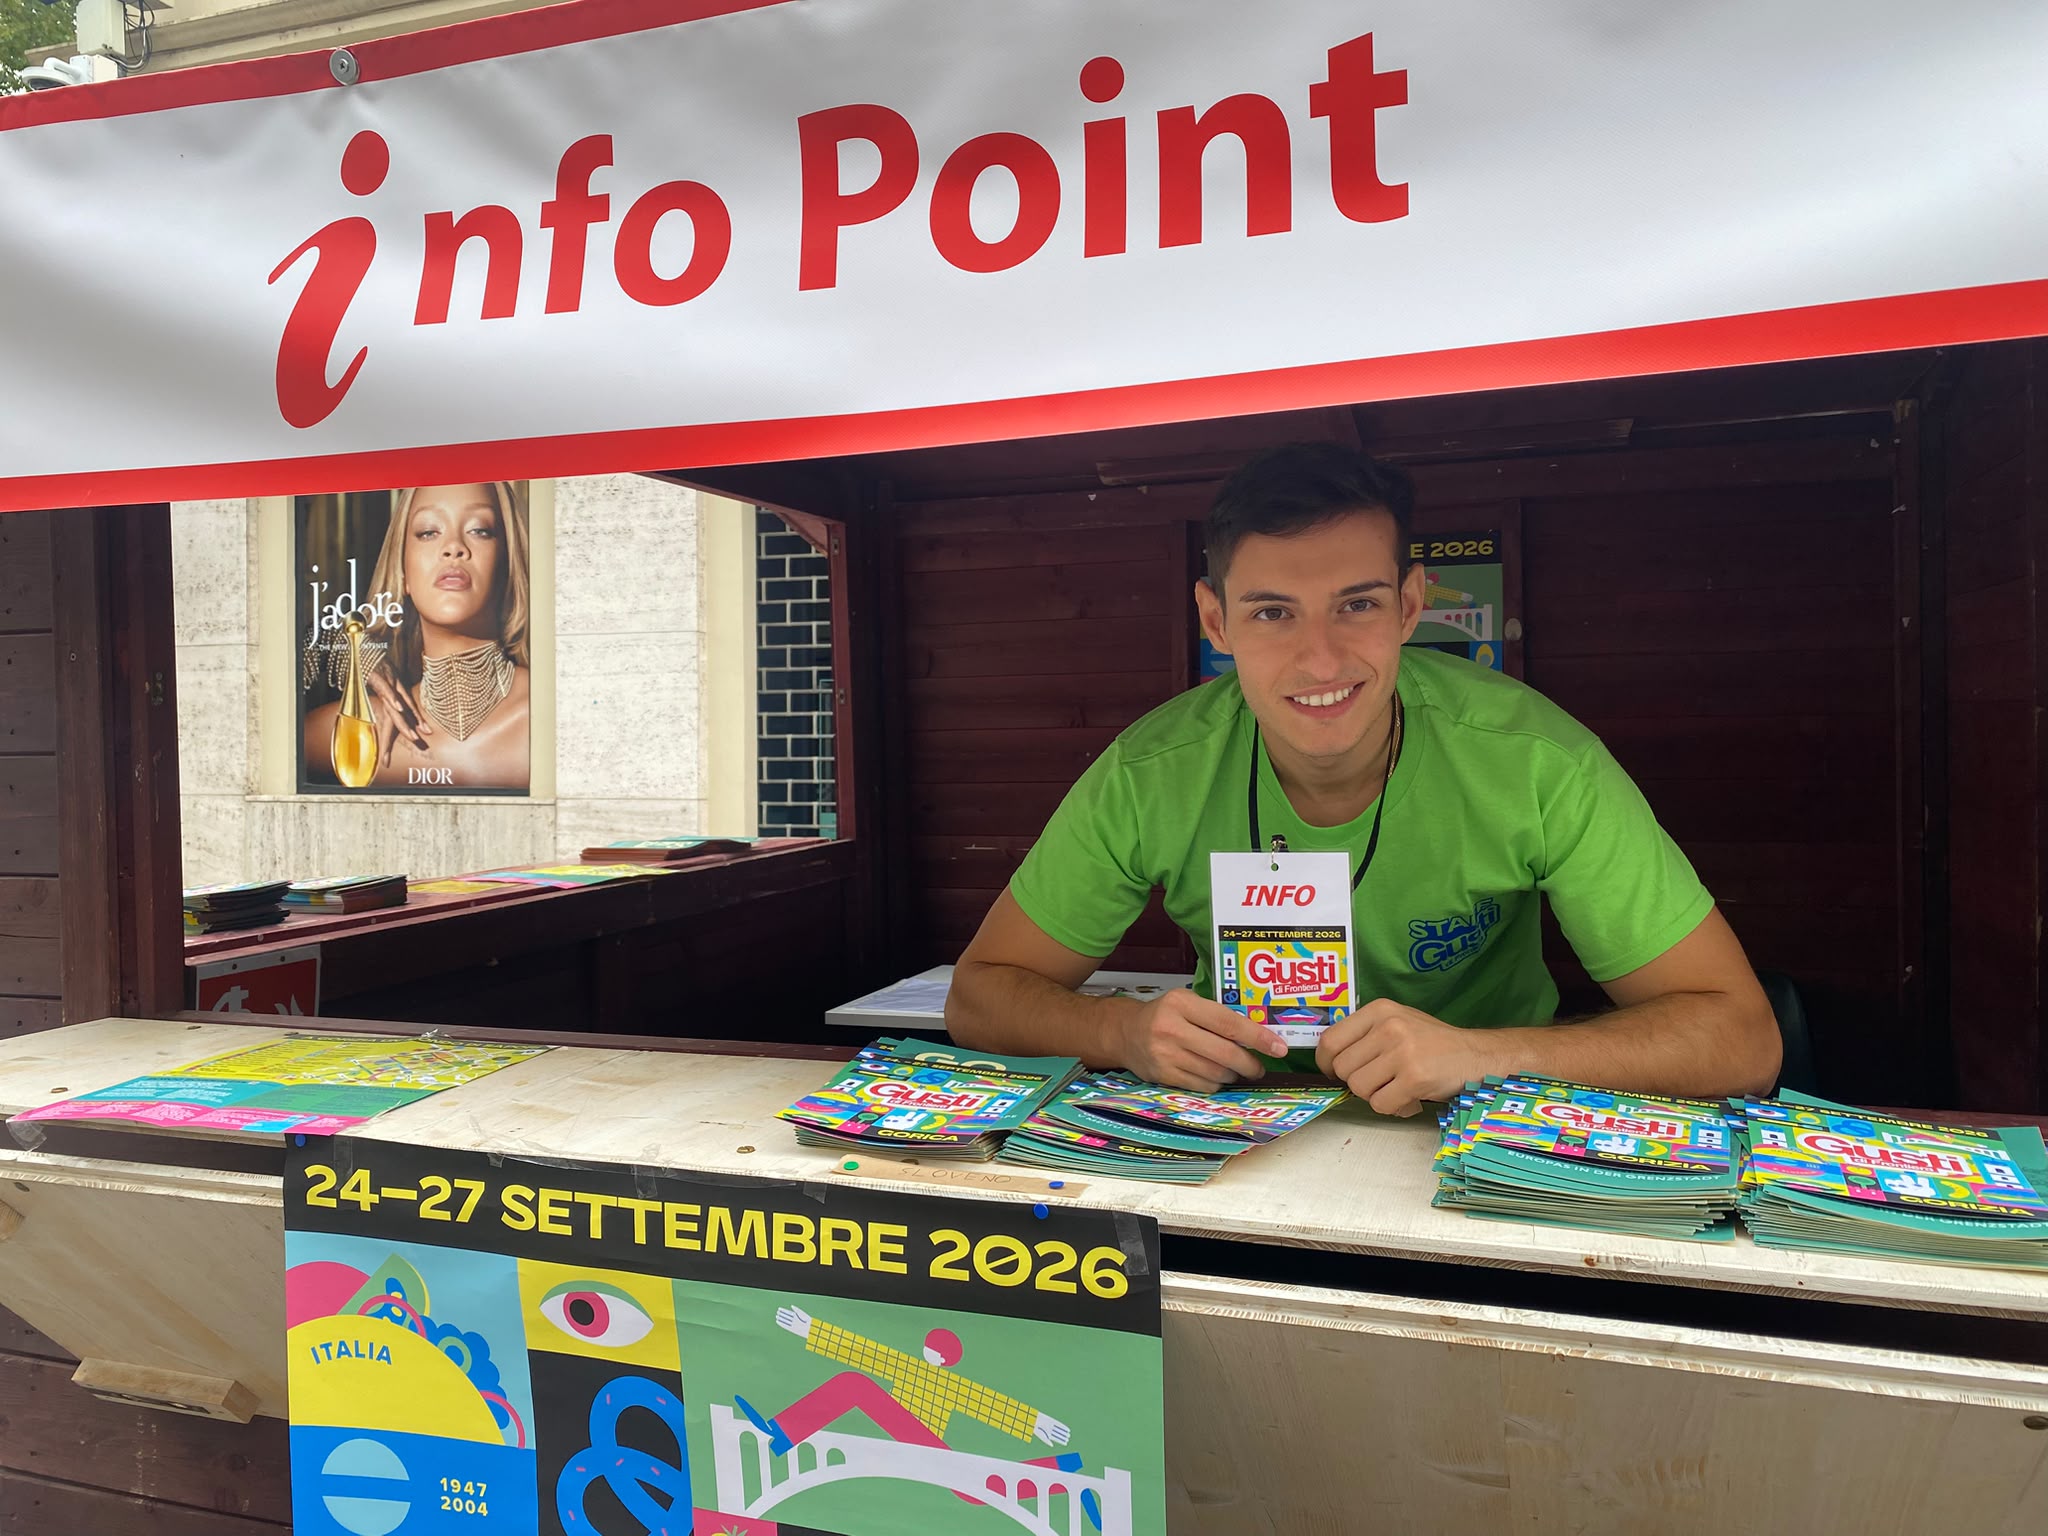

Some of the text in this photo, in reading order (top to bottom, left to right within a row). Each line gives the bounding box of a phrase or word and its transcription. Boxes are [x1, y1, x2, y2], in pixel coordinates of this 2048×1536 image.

[268, 31, 1410, 430] info Point
[1430, 540, 1494, 557] 2026
[308, 558, 404, 649] j'adore
[408, 767, 453, 785] DIOR
[1241, 884, 1316, 907] INFO
[1254, 930, 1313, 939] SETTEMBRE
[1315, 931, 1342, 939] 2026
[1248, 953, 1336, 984] Gusti
[1275, 983, 1319, 994] di Frontiera
[930, 1063, 1008, 1078] SEPTEMBER
[1008, 1073, 1044, 1081] 2026
[869, 1082, 986, 1110] Gusti
[1572, 1084, 1671, 1102] SETTEMBRE
[1166, 1094, 1284, 1118] Gusti
[1540, 1105, 1678, 1136] Gusti
[1589, 1123, 1648, 1136] Frontiera
[1819, 1109, 1934, 1130] SETTEMBRE
[1937, 1124, 1989, 1138] 2026
[877, 1129, 960, 1142] GORICA
[1118, 1145, 1206, 1160] GORICA
[1597, 1152, 1712, 1171] GORIZIA
[1803, 1135, 1965, 1174] Gusti
[900, 1167, 1012, 1184] SLOVENO
[1508, 1150, 1571, 1169] EUROPAS
[1593, 1168, 1621, 1179] DER
[1625, 1173, 1723, 1182] GRENZSTADT
[1869, 1158, 1934, 1173] Frontiera
[1899, 1195, 2035, 1216] GORIZIA
[304, 1164, 1129, 1300] 24–27 SETTEMBRE 2026
[310, 1339, 393, 1365] ITALIA
[440, 1477, 487, 1497] 1947
[440, 1495, 489, 1516] 2004
